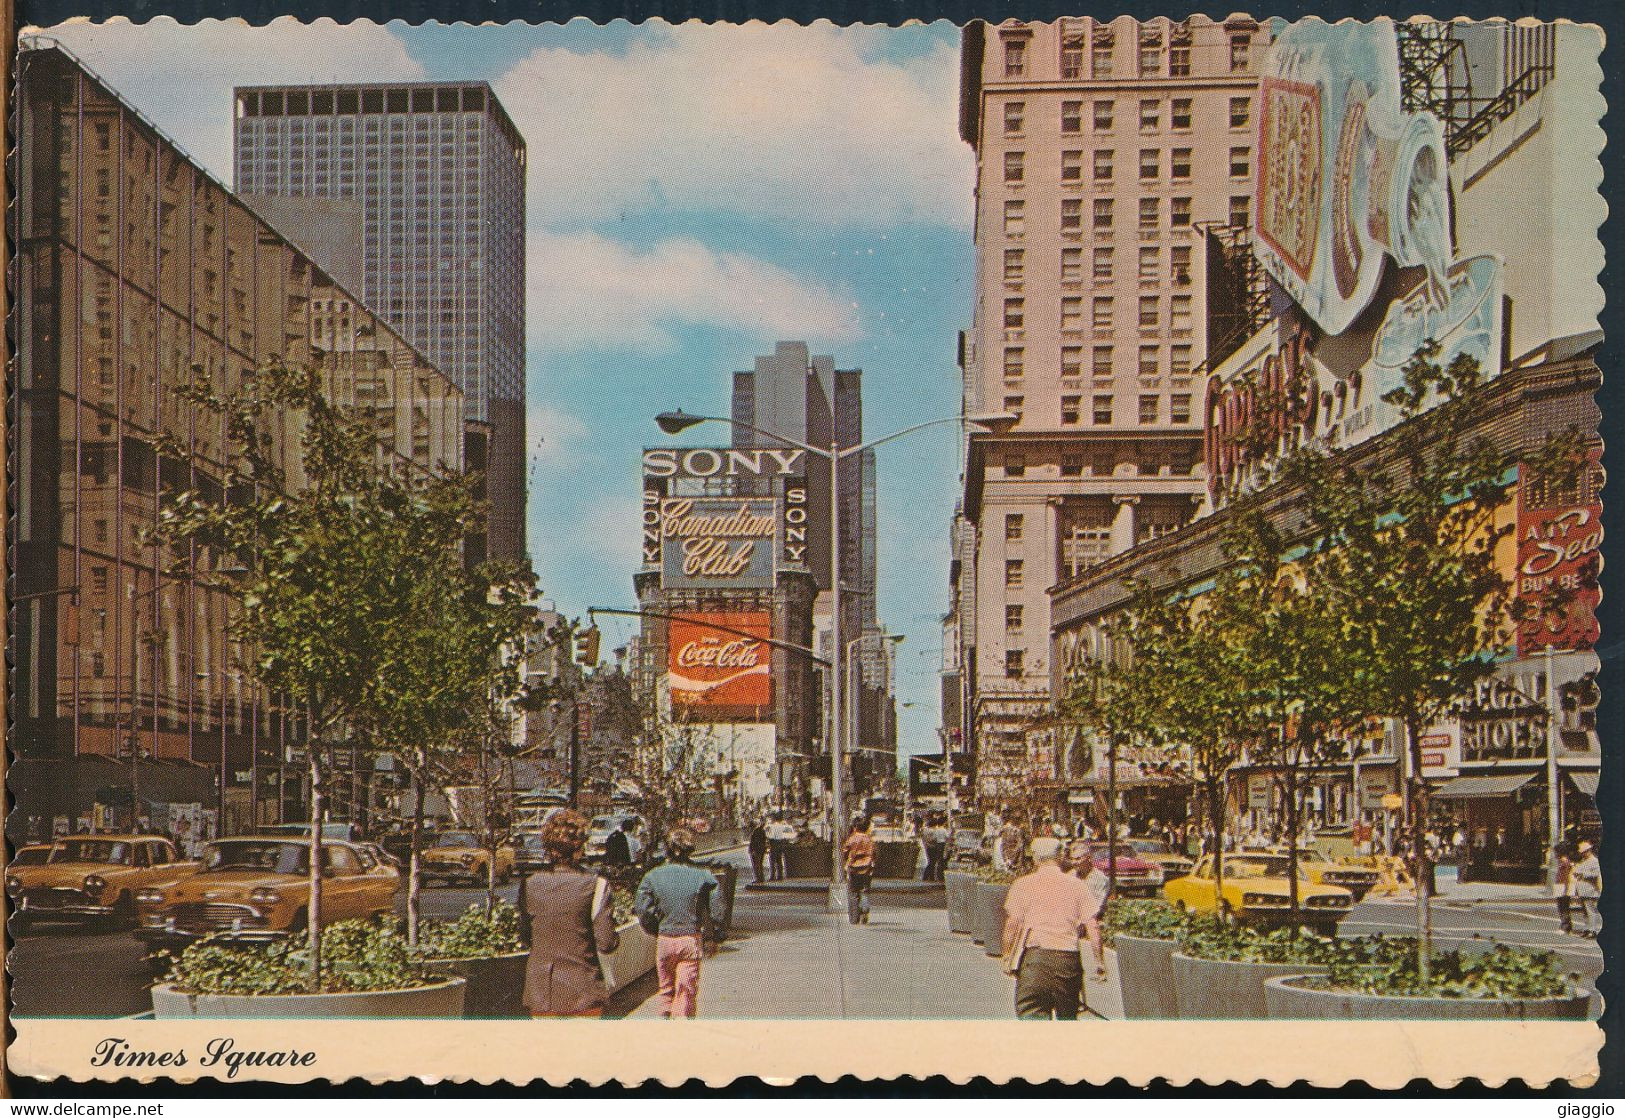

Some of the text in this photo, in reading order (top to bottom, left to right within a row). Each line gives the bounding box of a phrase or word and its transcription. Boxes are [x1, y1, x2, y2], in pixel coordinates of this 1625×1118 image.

[643, 449, 806, 477] SONY
[643, 490, 660, 561] SONY
[662, 500, 777, 537] Canadian
[785, 488, 807, 560] SONY
[682, 537, 754, 576] Club
[678, 638, 761, 668] Coca-Cola
